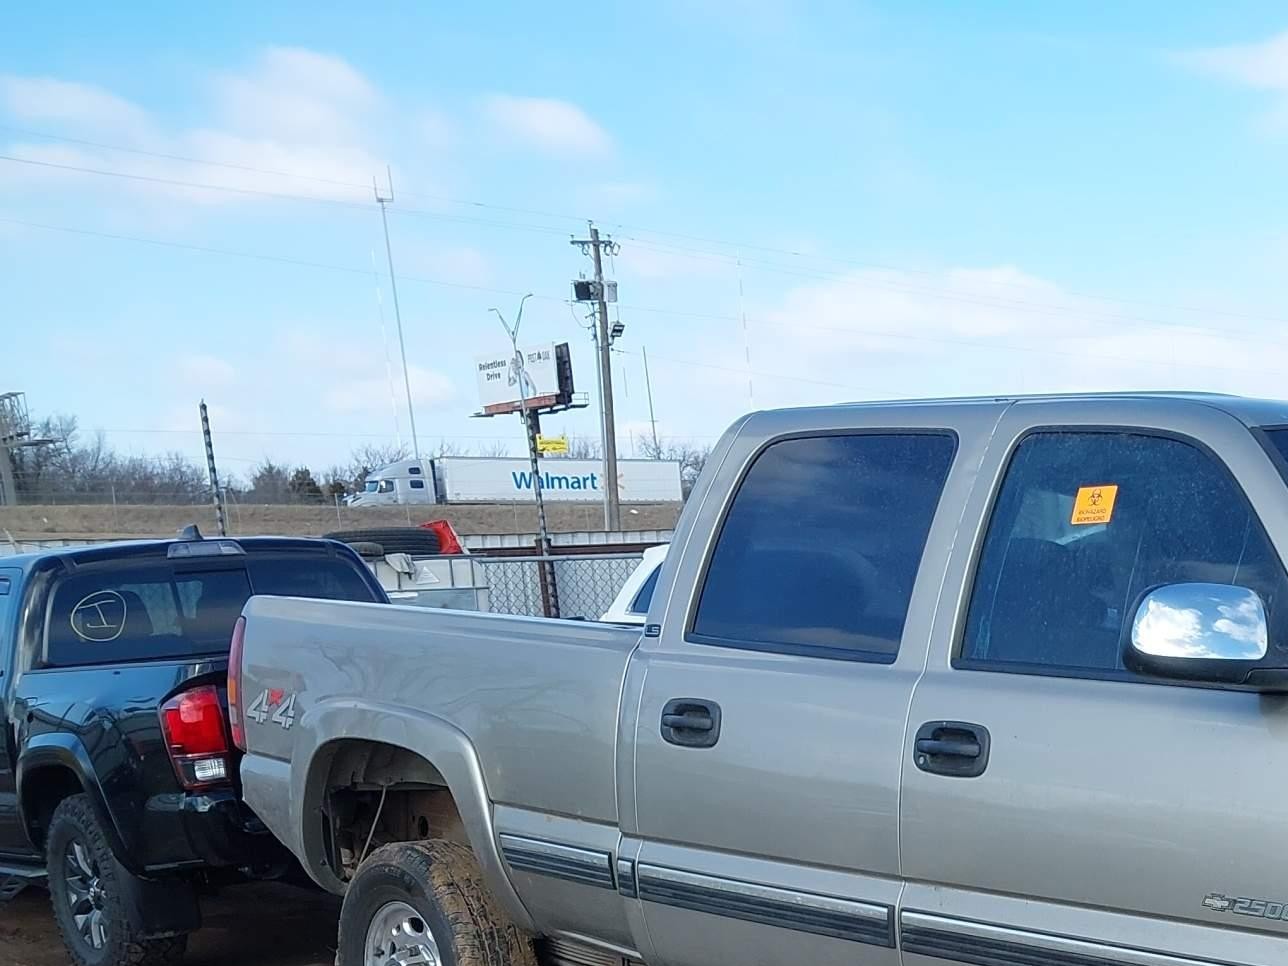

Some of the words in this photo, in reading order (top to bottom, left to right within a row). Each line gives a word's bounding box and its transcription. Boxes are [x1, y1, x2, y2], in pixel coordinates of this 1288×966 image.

[478, 360, 507, 371] Relentless
[486, 372, 501, 382] Drive
[512, 471, 598, 490] Walmart
